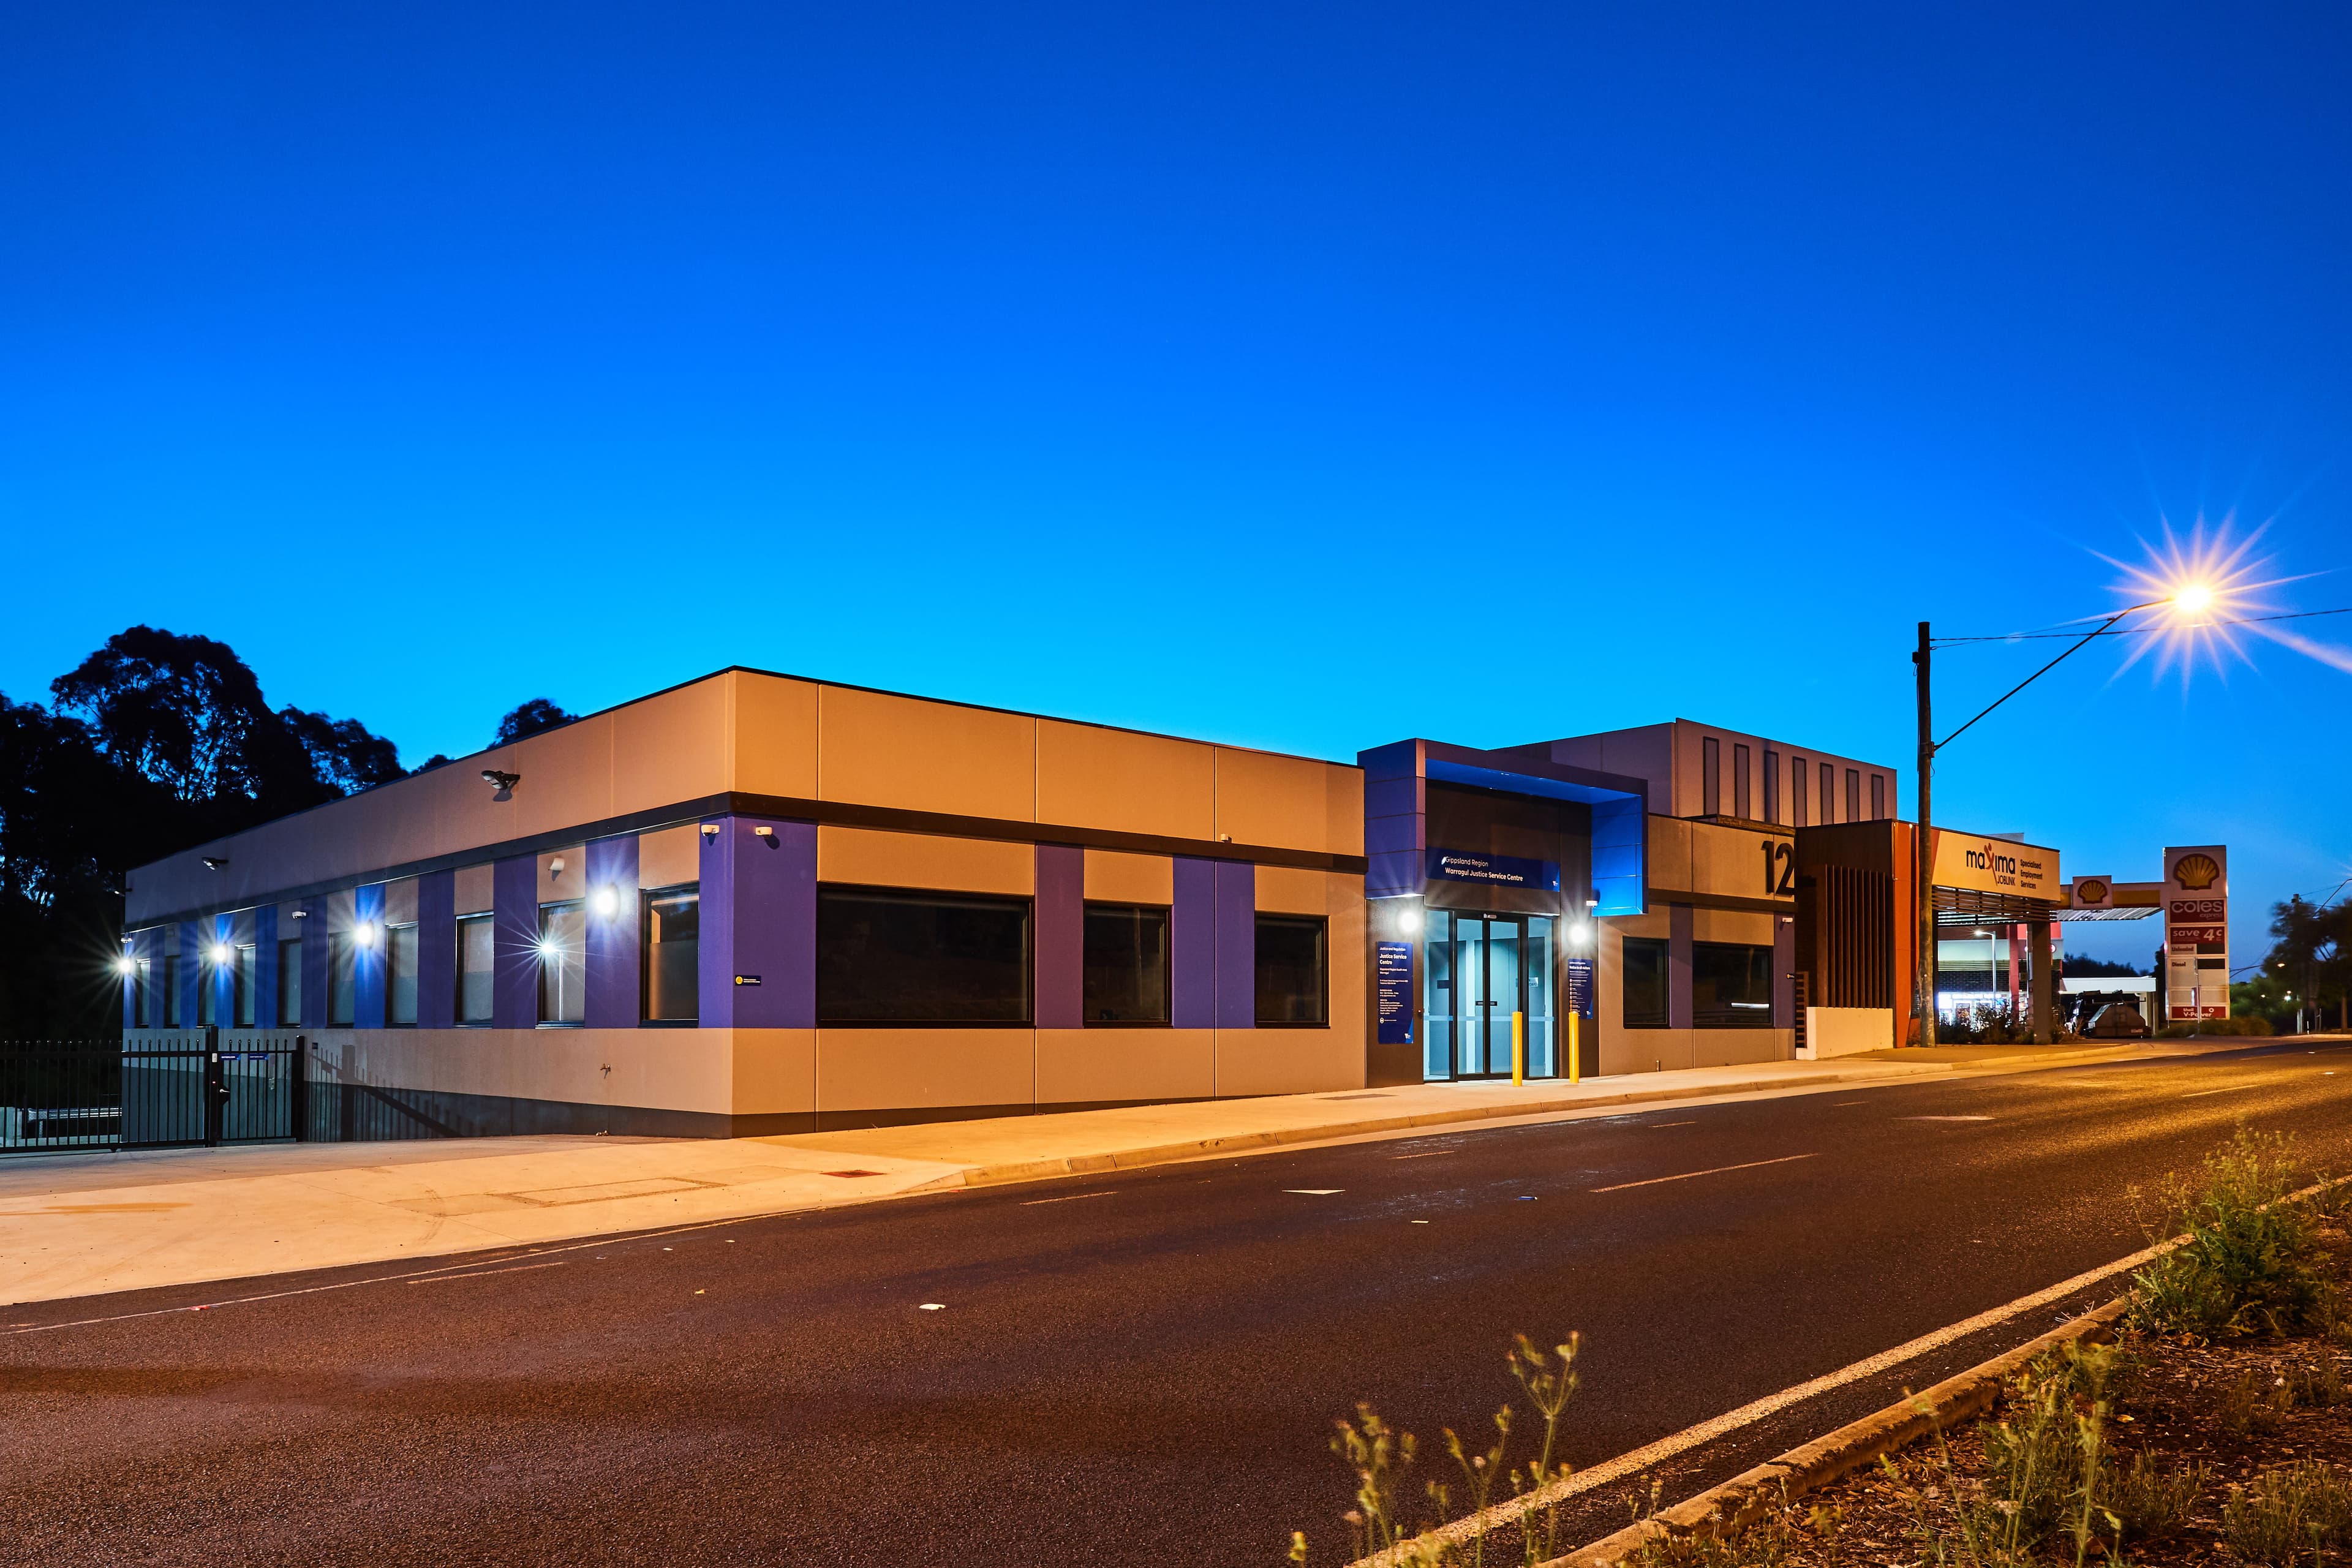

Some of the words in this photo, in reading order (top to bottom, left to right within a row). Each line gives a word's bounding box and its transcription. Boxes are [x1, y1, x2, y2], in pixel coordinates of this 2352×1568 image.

[1446, 856, 1471, 865] Gippsland
[1966, 843, 2016, 876] maxima
[2020, 859, 2041, 869] Specialised
[1445, 867, 1469, 876] Warragul
[1761, 841, 1795, 897] 12
[2020, 870, 2043, 880] Employment
[1997, 875, 2016, 886] JOBLINK
[2020, 880, 2037, 889] Services
[2171, 900, 2223, 913] coles
